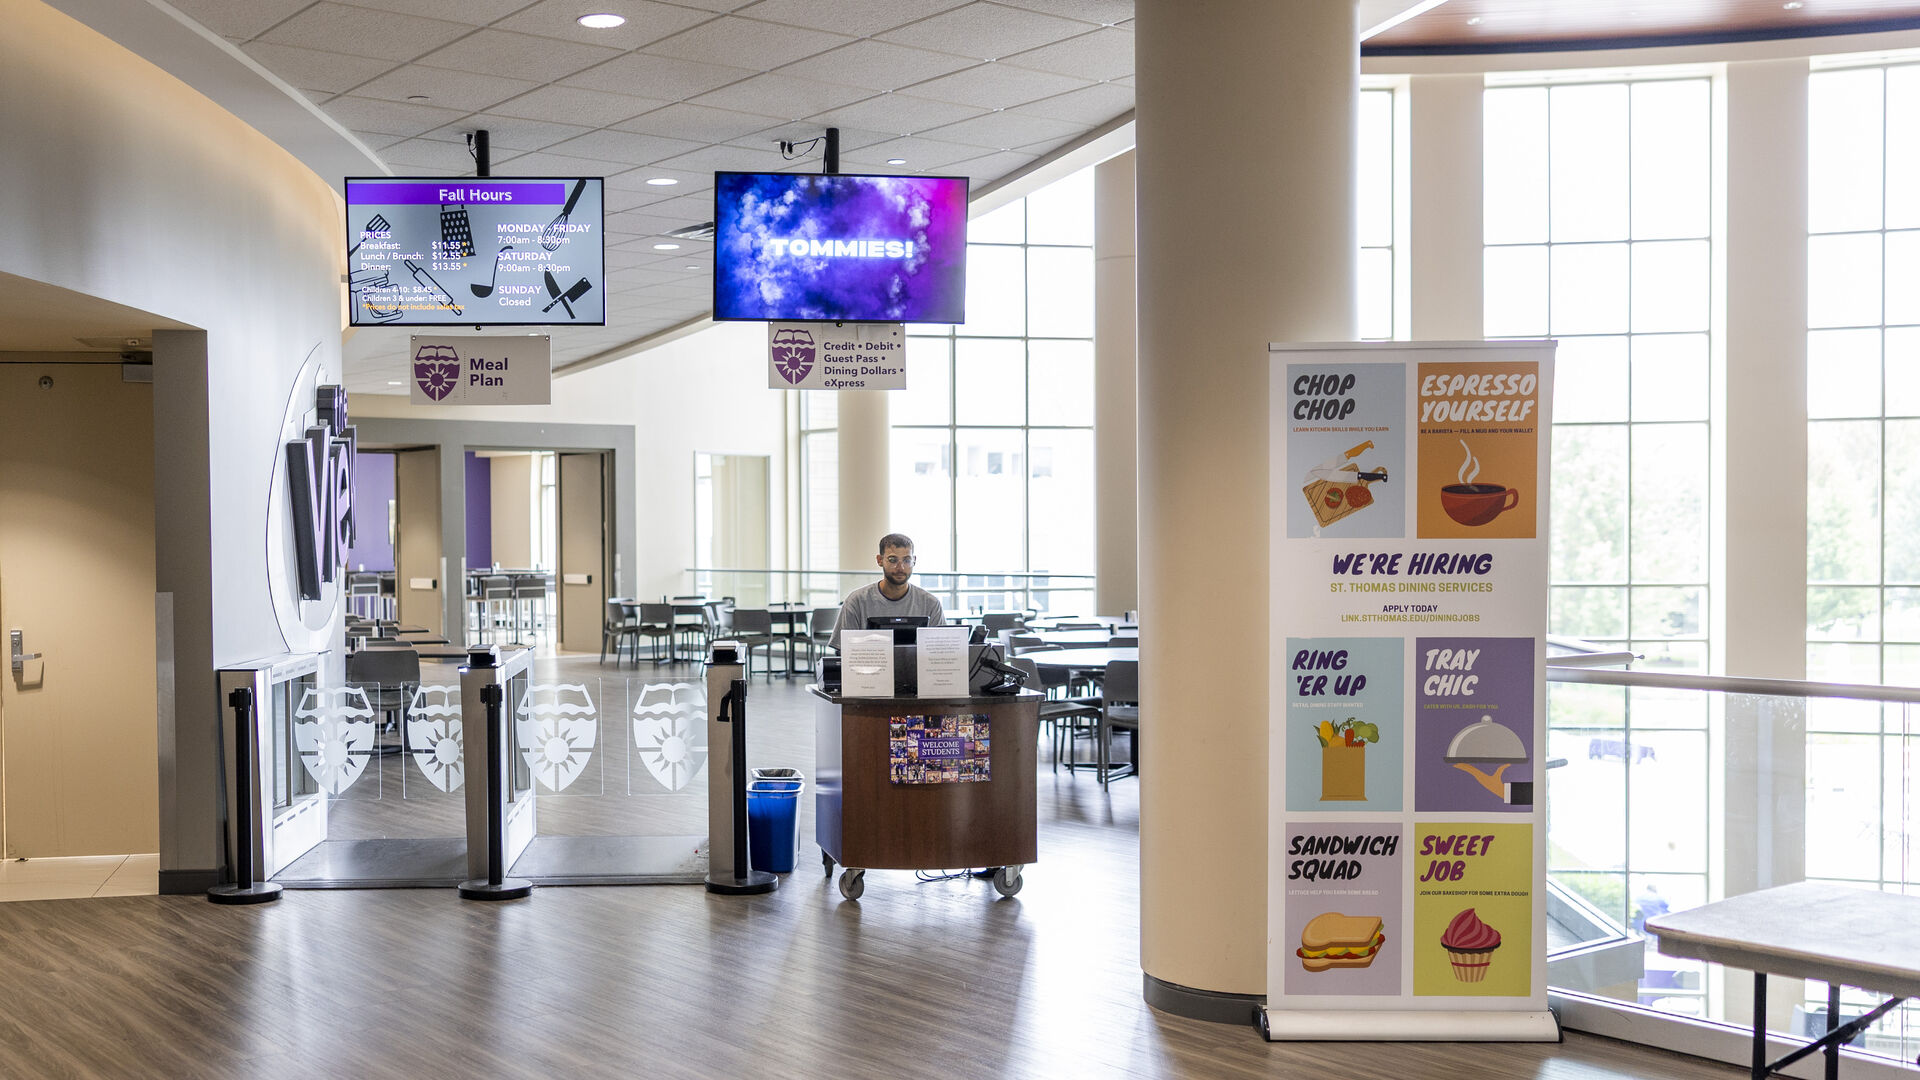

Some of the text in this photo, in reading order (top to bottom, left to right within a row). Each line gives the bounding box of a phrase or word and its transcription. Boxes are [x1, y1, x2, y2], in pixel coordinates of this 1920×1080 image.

[440, 188, 513, 202] Fall Hours
[497, 224, 546, 232] MONDAY
[553, 224, 591, 232] FRIDAY
[360, 231, 392, 239] PRICES
[498, 236, 530, 244] 7:00am
[537, 236, 570, 246] 8:30pm
[360, 241, 460, 250] Breakfast: $11.55
[770, 239, 913, 258] TOMMIES!
[360, 252, 461, 260] Lunch / Brunch: $12.55
[498, 252, 553, 260] SATURDAY
[360, 262, 461, 270] Dinner: $13.55
[498, 264, 530, 272] 9:00am
[538, 264, 570, 274] 8:30pm
[498, 286, 542, 294] SUNDAY
[499, 297, 531, 306] Closed
[824, 342, 894, 351] Credit Debit
[470, 357, 508, 371] Meal
[824, 354, 878, 363] Guest Pass
[824, 366, 897, 377] Dining Dollars
[470, 373, 504, 386] Plan
[824, 379, 865, 389] eXpress
[1293, 374, 1356, 396] CHOP
[1421, 374, 1537, 396] ESPRESSO
[1293, 398, 1355, 420] CHOP
[1421, 400, 1534, 422] YOURSELF
[1333, 553, 1493, 575] WE'RE HIRING
[1330, 583, 1493, 592] ST. THOMAS DINING SERVICES
[1341, 614, 1480, 623] LINK.STTHOMAS.EDU/DININGJOBS
[1292, 650, 1348, 670] RING
[1425, 649, 1480, 671] TRAY
[1297, 675, 1366, 696] 'ER UP
[1424, 674, 1479, 696] CHIC
[1288, 835, 1399, 856] SANDWICH
[1420, 835, 1495, 856] SWEET
[1288, 859, 1362, 882] SQUAD
[1420, 860, 1466, 882] JOB
